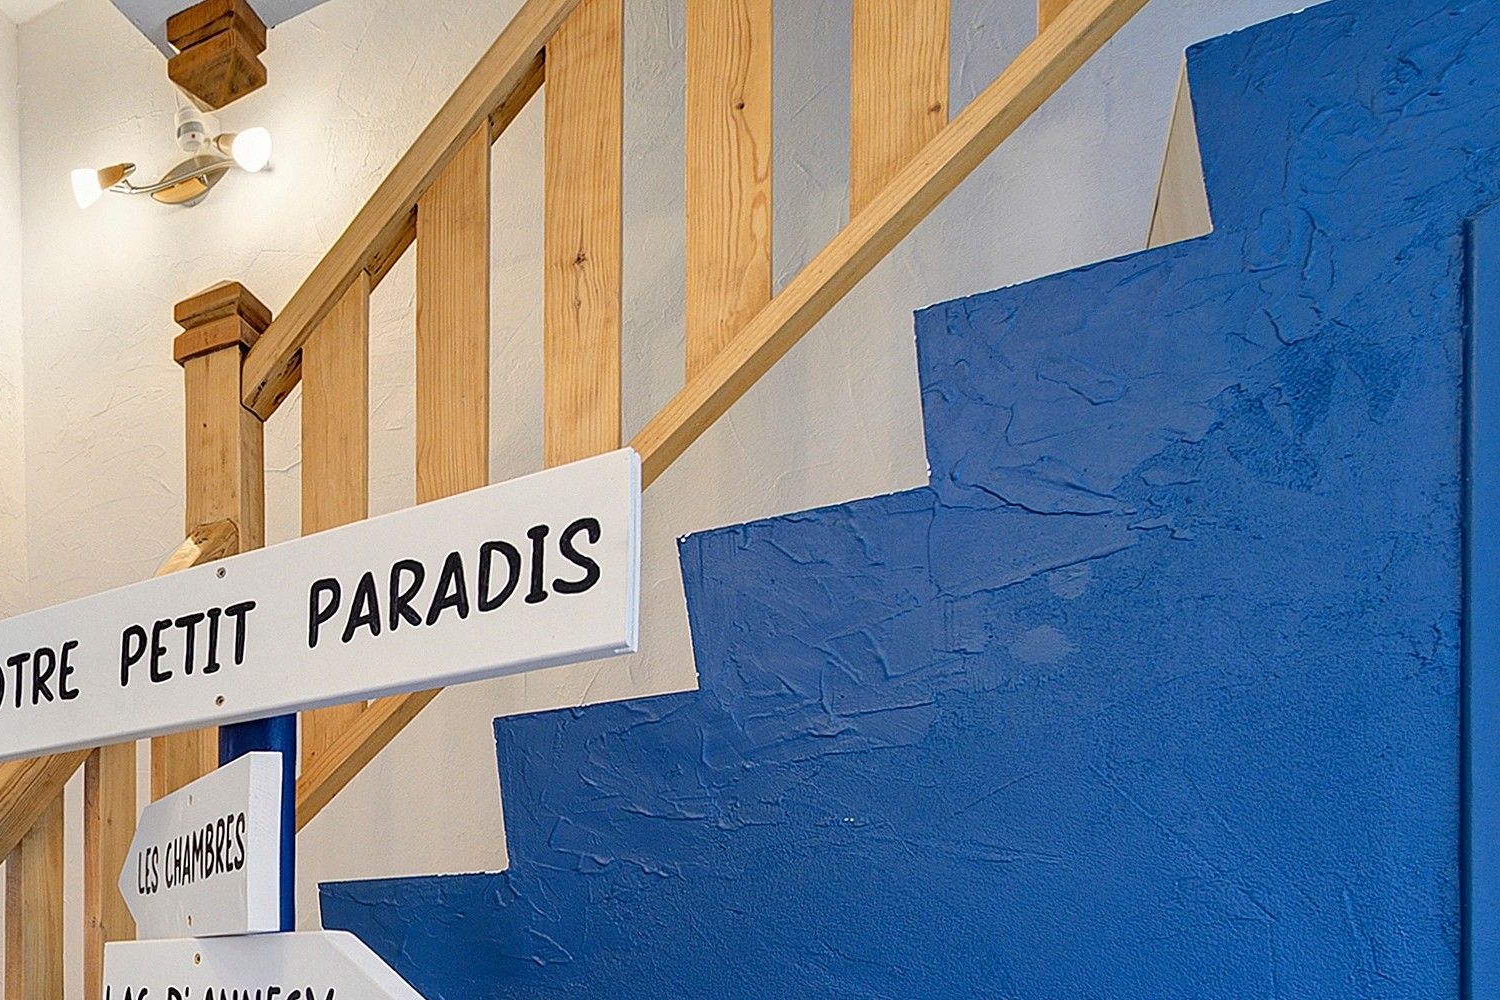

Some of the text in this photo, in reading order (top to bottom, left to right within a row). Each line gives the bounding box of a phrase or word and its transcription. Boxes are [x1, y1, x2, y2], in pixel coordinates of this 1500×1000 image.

[120, 600, 257, 687] PETIT
[308, 517, 601, 649] PARADIS
[138, 812, 246, 896] LES CHAMBRES
